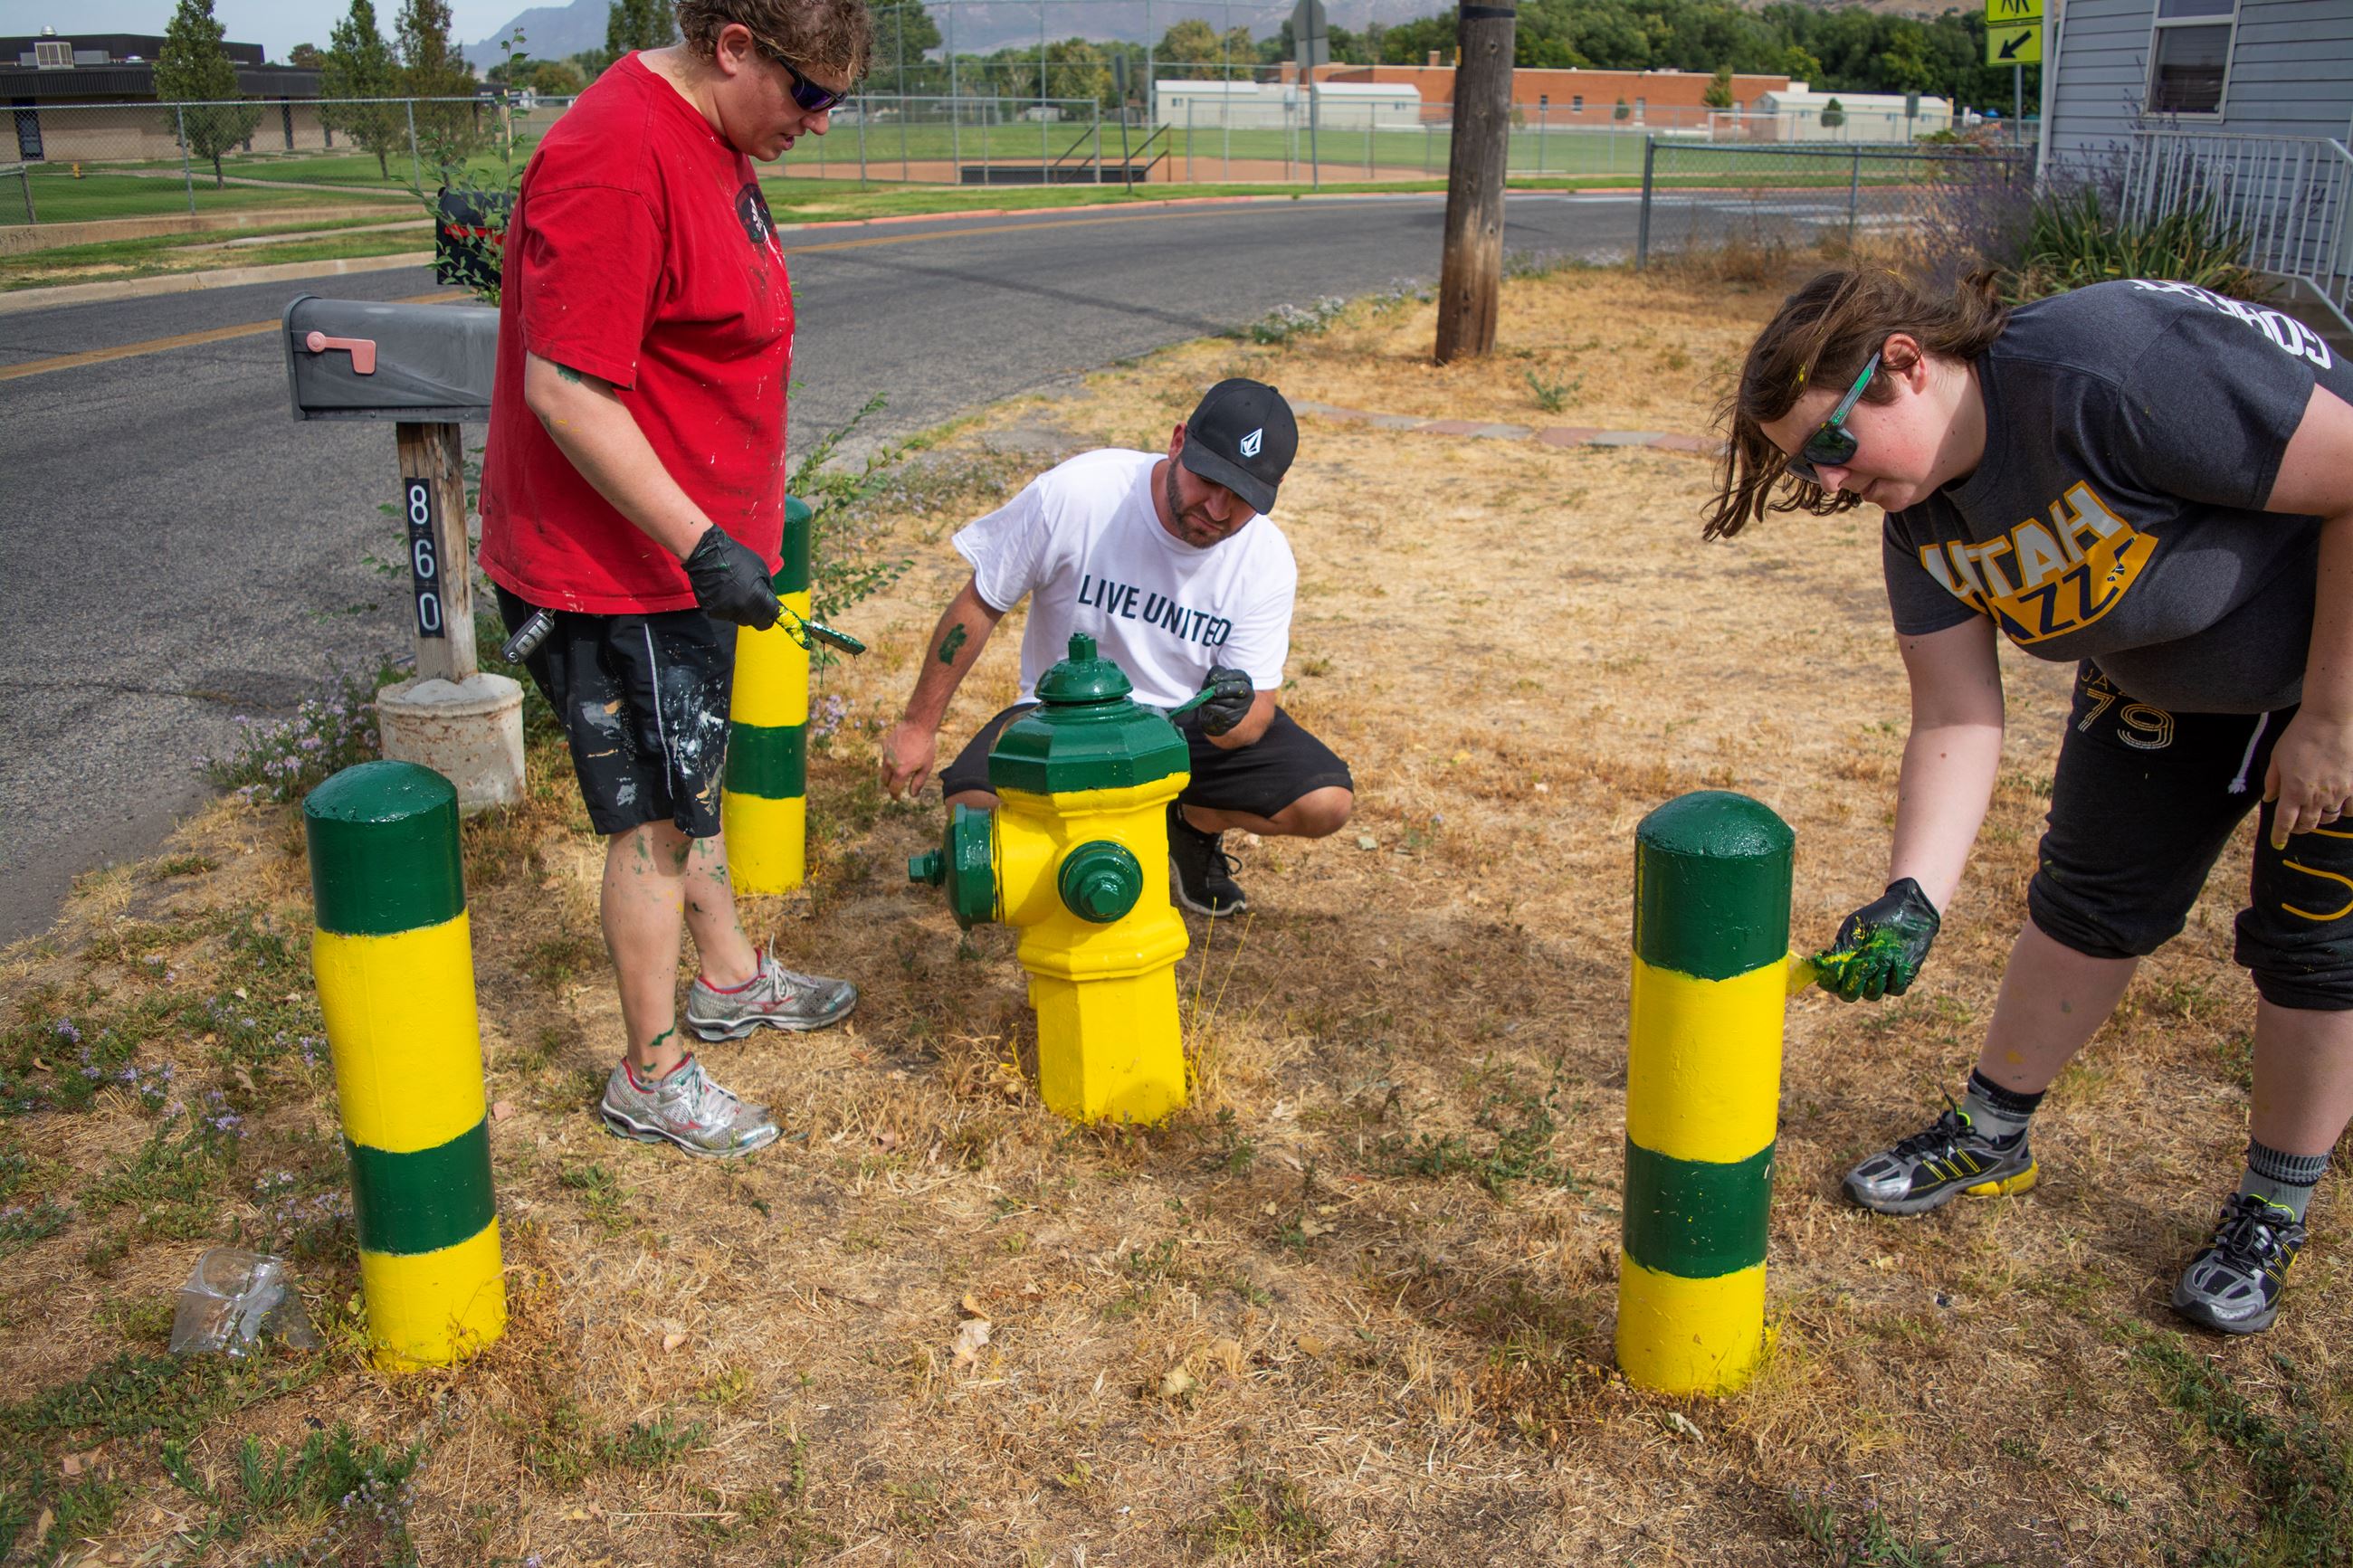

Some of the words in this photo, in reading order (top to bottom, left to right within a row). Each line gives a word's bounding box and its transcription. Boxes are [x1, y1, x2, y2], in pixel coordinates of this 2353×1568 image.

[409, 484, 441, 632] 860
[1920, 480, 2129, 599] UTAH
[1078, 575, 1140, 620] LIVE
[1142, 592, 1232, 647] UNITED
[2077, 687, 2175, 750] 79
